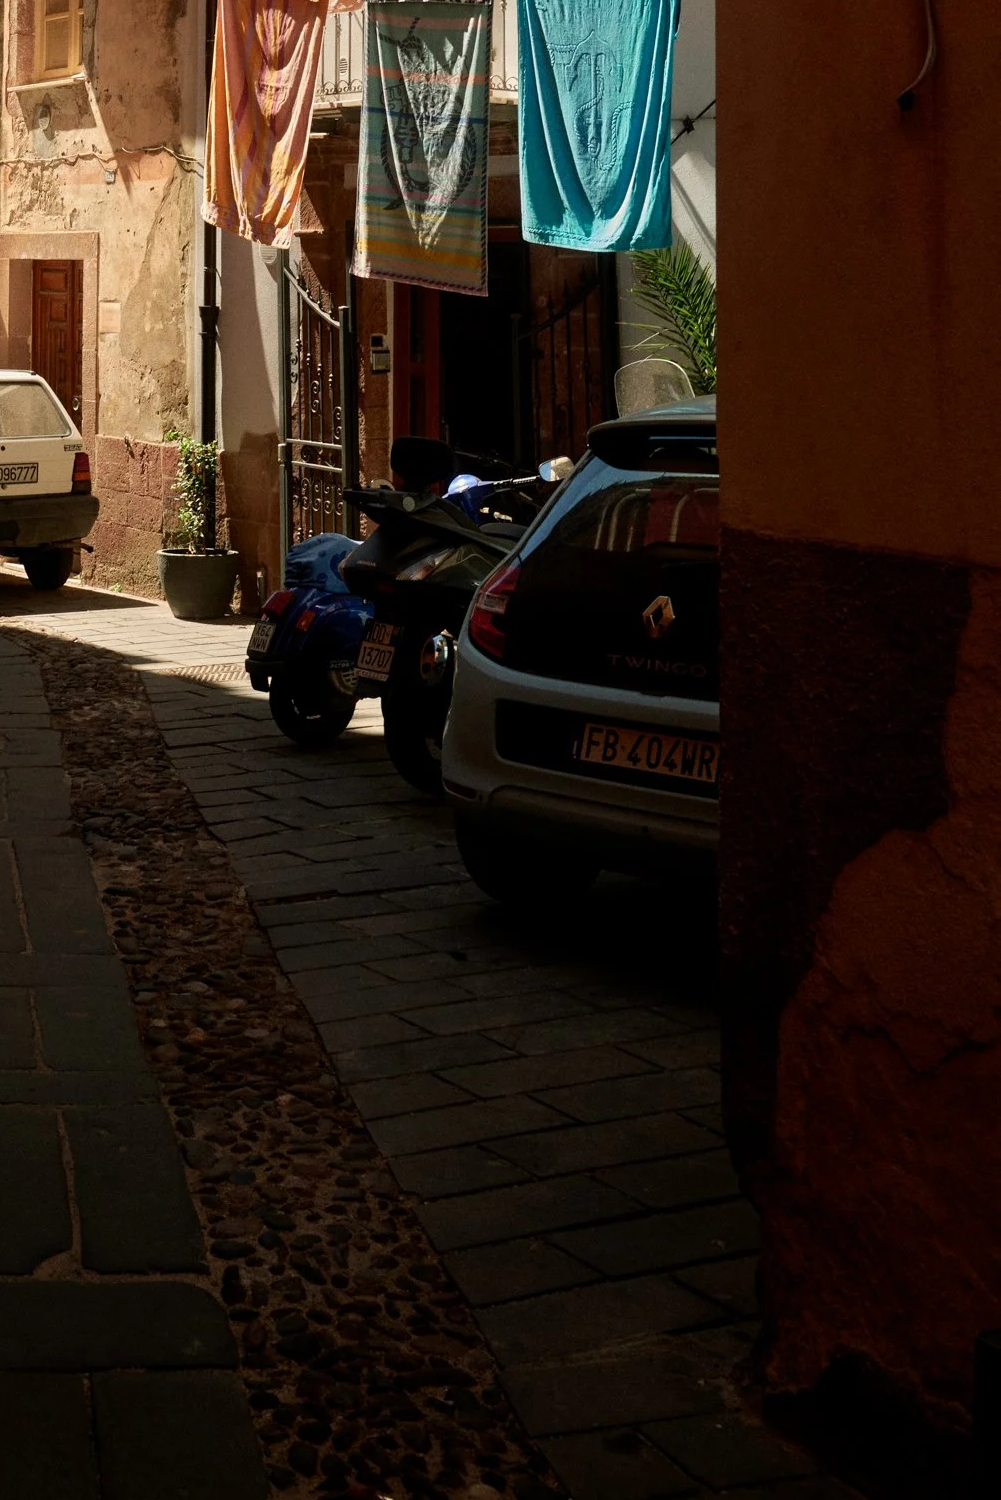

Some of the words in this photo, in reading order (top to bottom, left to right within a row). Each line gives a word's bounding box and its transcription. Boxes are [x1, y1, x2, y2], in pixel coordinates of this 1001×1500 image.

[361, 646, 393, 669] 13707
[605, 653, 707, 678] TWINGO
[585, 727, 619, 761] FB
